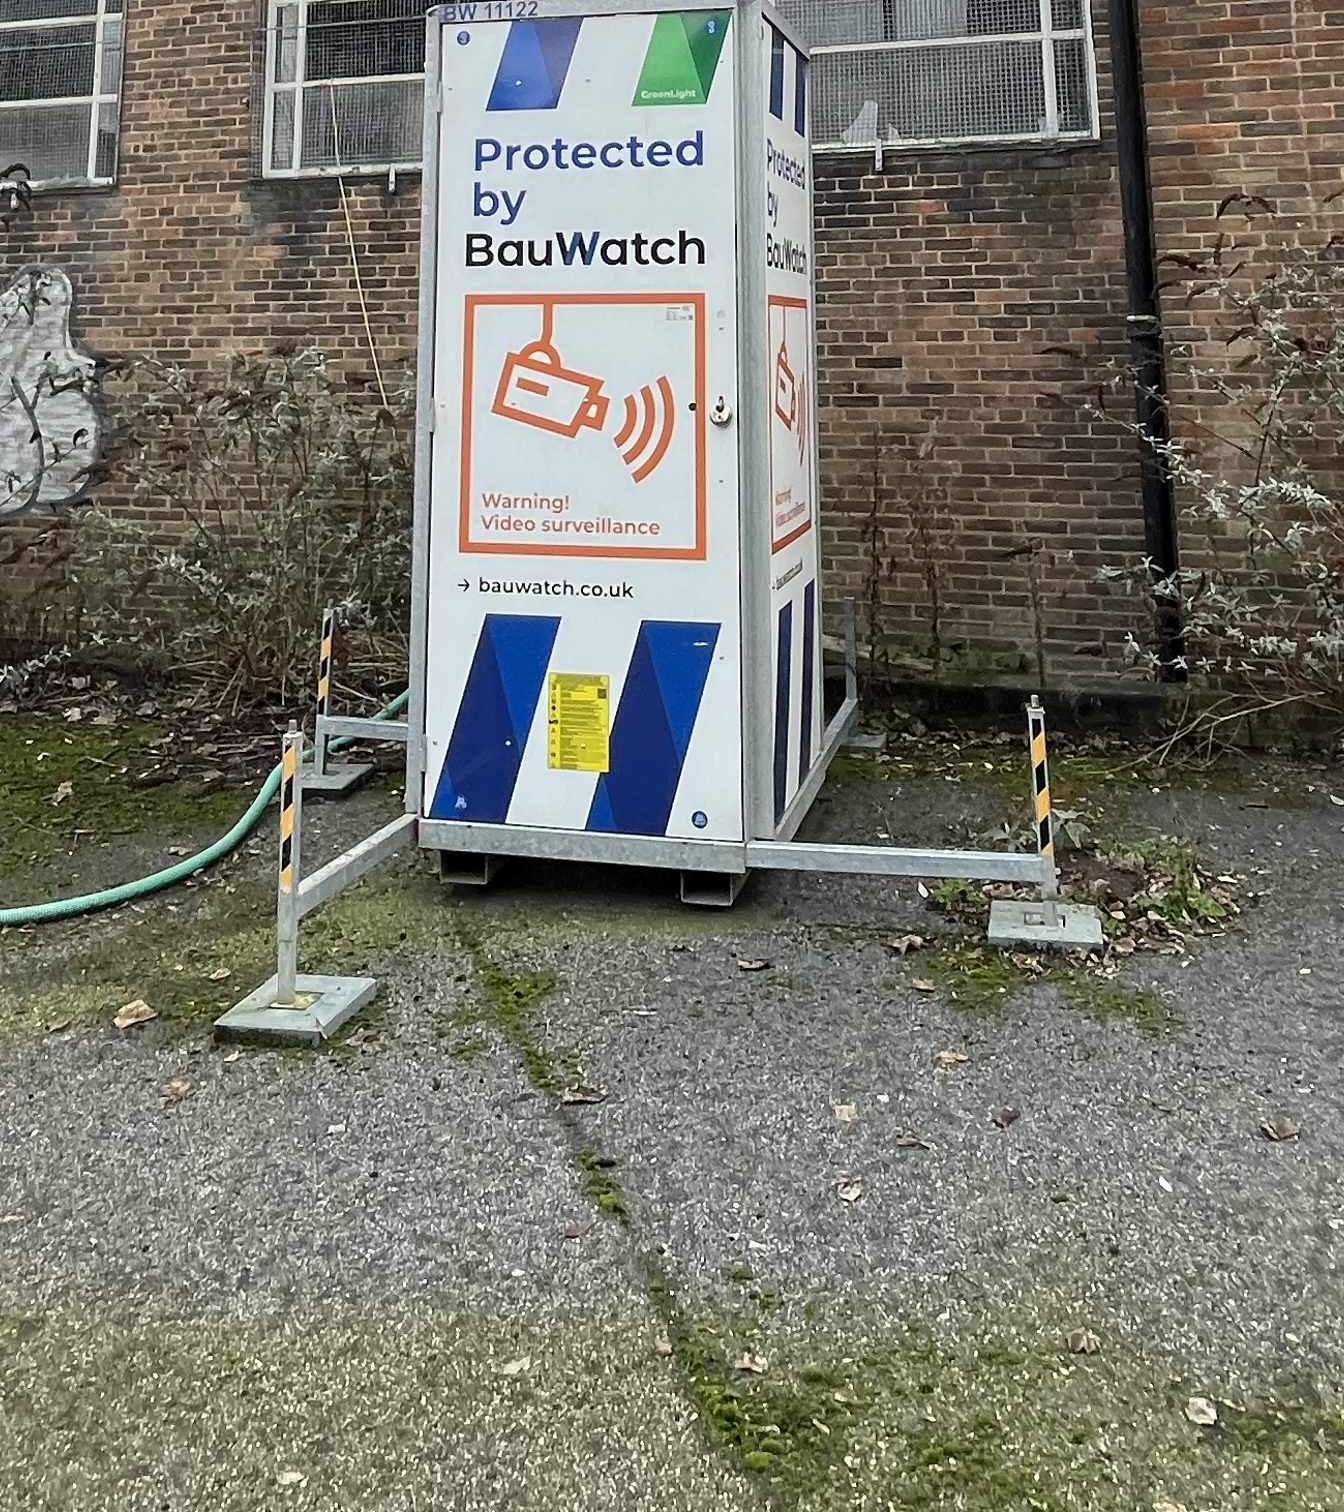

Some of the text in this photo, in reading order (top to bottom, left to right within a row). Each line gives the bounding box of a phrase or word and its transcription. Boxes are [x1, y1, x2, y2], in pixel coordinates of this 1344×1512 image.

[444, 0, 539, 21] BW 11122
[640, 88, 697, 100] GreenLight
[473, 129, 705, 172] Protected
[472, 182, 527, 225] by
[464, 230, 706, 268] BauWatch
[481, 493, 570, 513] Warning!
[481, 514, 661, 536] Video surveillance
[478, 577, 634, 599] bauwatch.co.uk
